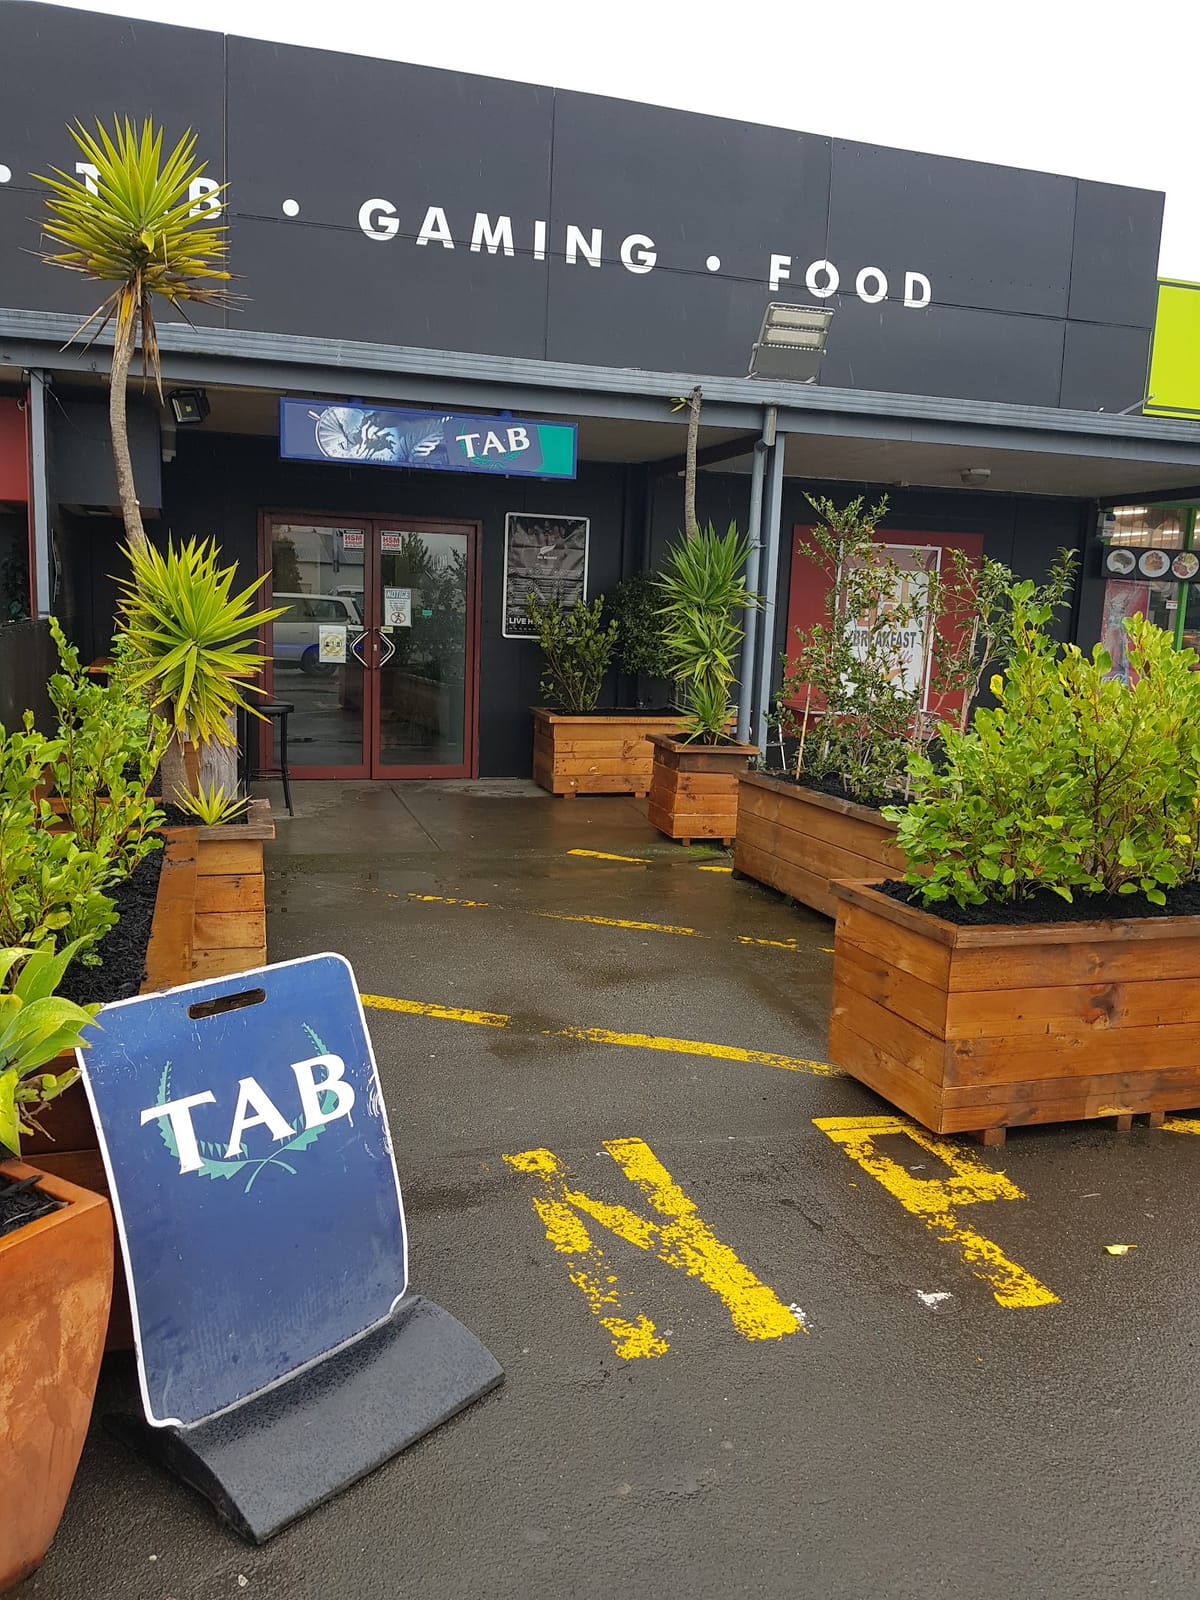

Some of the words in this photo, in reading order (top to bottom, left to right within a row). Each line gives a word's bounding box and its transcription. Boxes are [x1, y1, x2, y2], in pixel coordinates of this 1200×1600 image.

[75, 162, 222, 220] TB
[358, 198, 658, 274] GAMING
[768, 253, 932, 309] FOOD
[455, 427, 530, 458] TAB
[383, 536, 400, 544] HSM
[387, 590, 409, 599] NOTICE
[509, 617, 527, 625] LIVE
[140, 1054, 355, 1174] TAB
